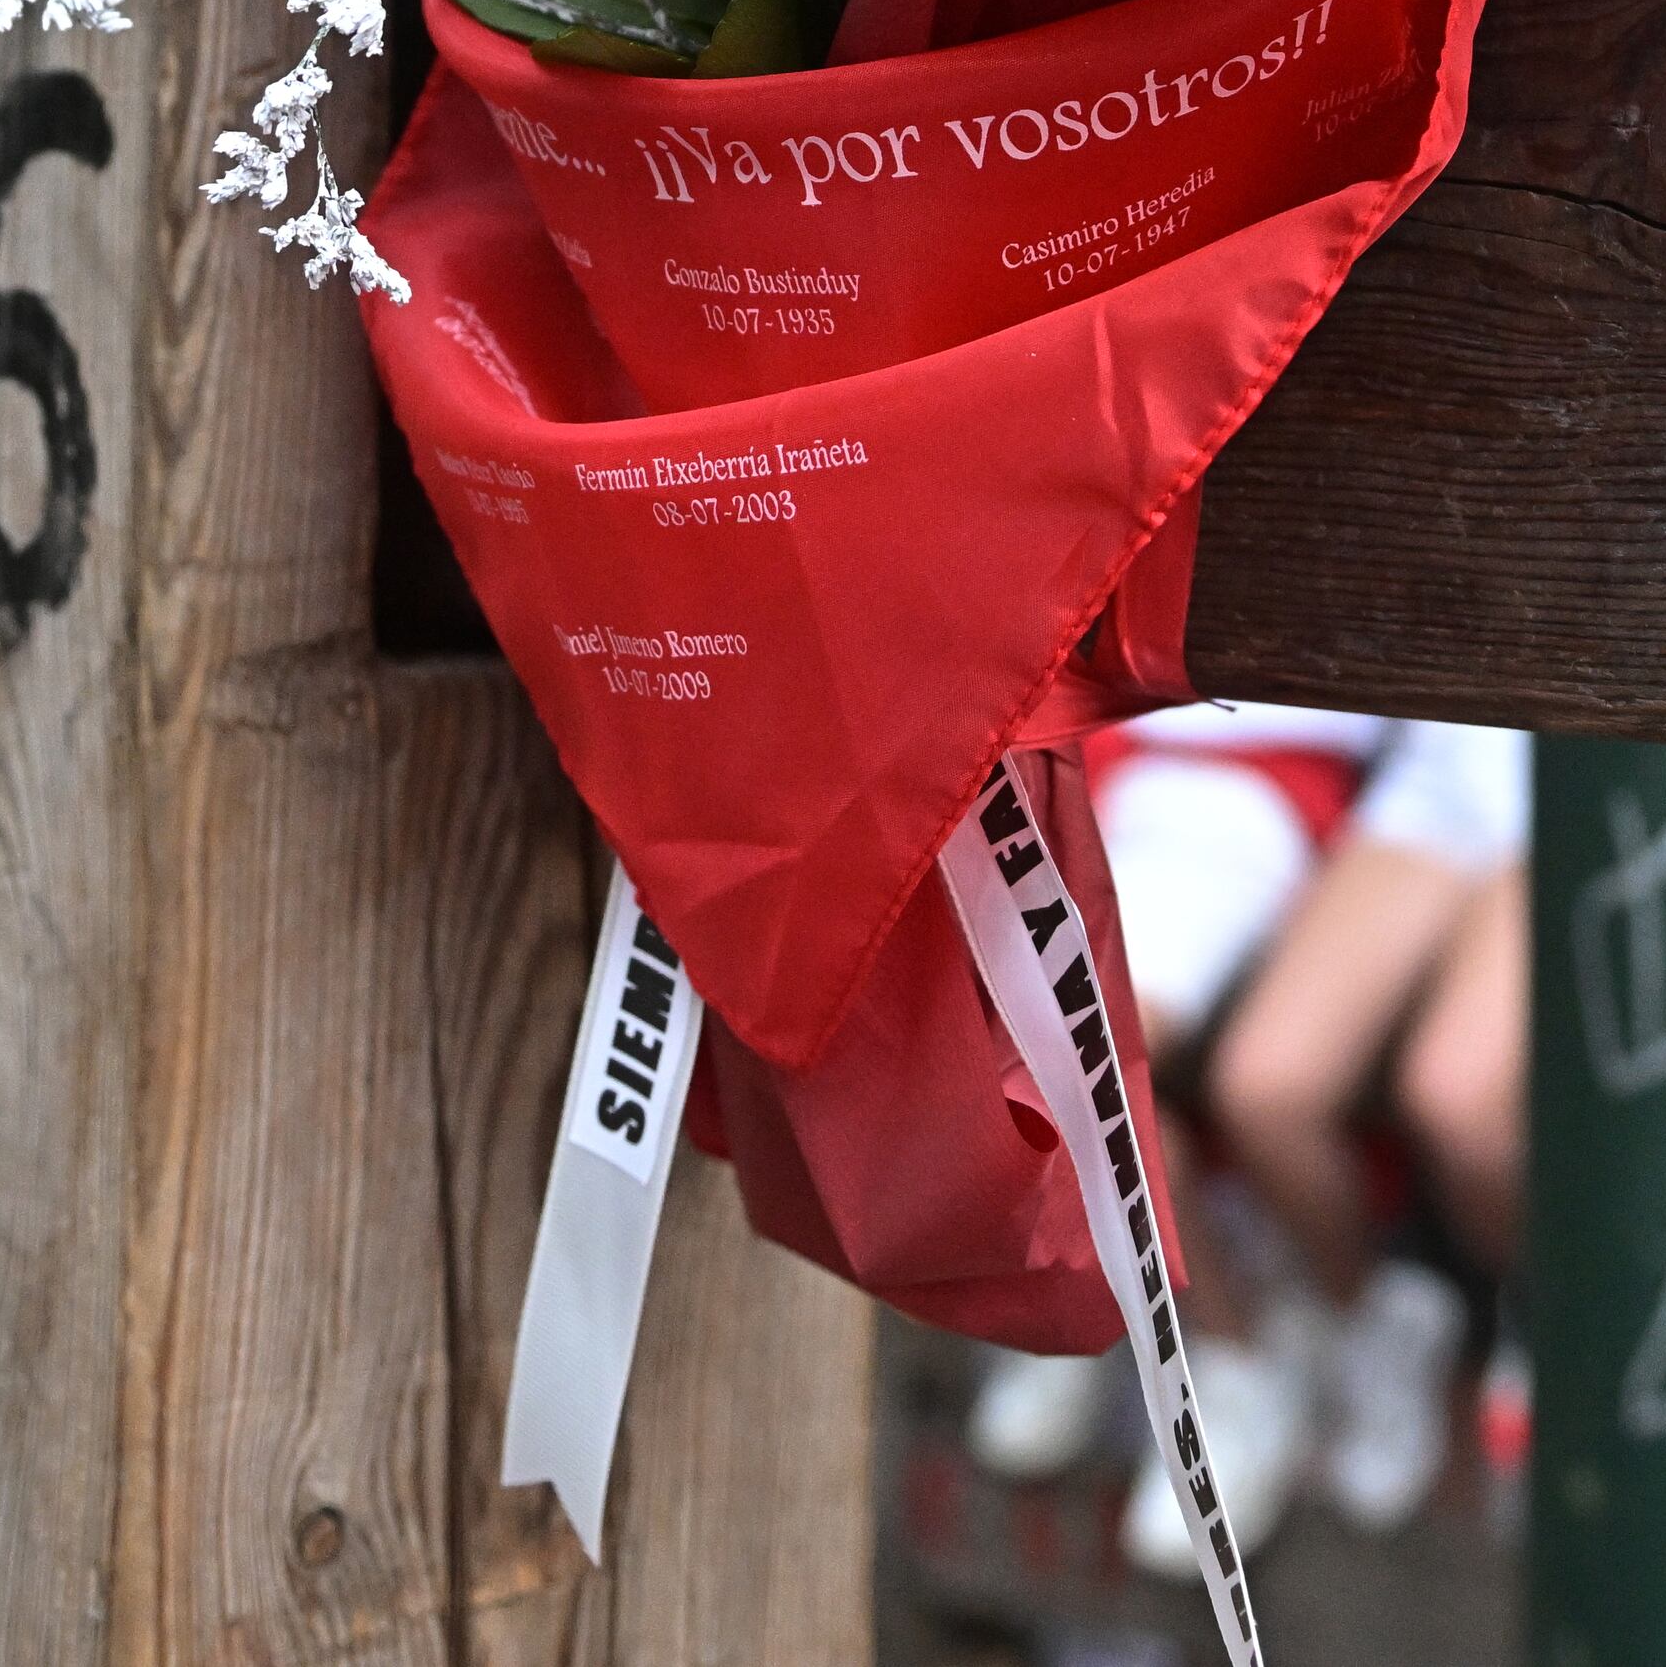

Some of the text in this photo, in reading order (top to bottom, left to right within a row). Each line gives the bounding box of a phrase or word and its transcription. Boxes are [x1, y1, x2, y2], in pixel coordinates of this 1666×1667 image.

[634, 125, 772, 203] ¡¡Va
[781, 125, 921, 206] por
[1001, 166, 1216, 269] Casimiro Heredia
[1043, 205, 1192, 292] 10-07-1947
[664, 258, 861, 302] Gonzalo Bustinduy
[701, 303, 836, 335] 10-07-1935
[574, 437, 869, 492] Fermín Etxeberría Irañeta
[651, 489, 797, 528] 08-07-2003
[605, 626, 664, 660] Jimeno
[664, 630, 748, 658] Romero
[601, 666, 711, 701] 10-07-2009
[1021, 897, 1069, 957] Y
[1052, 951, 1177, 1366] HERMANA
